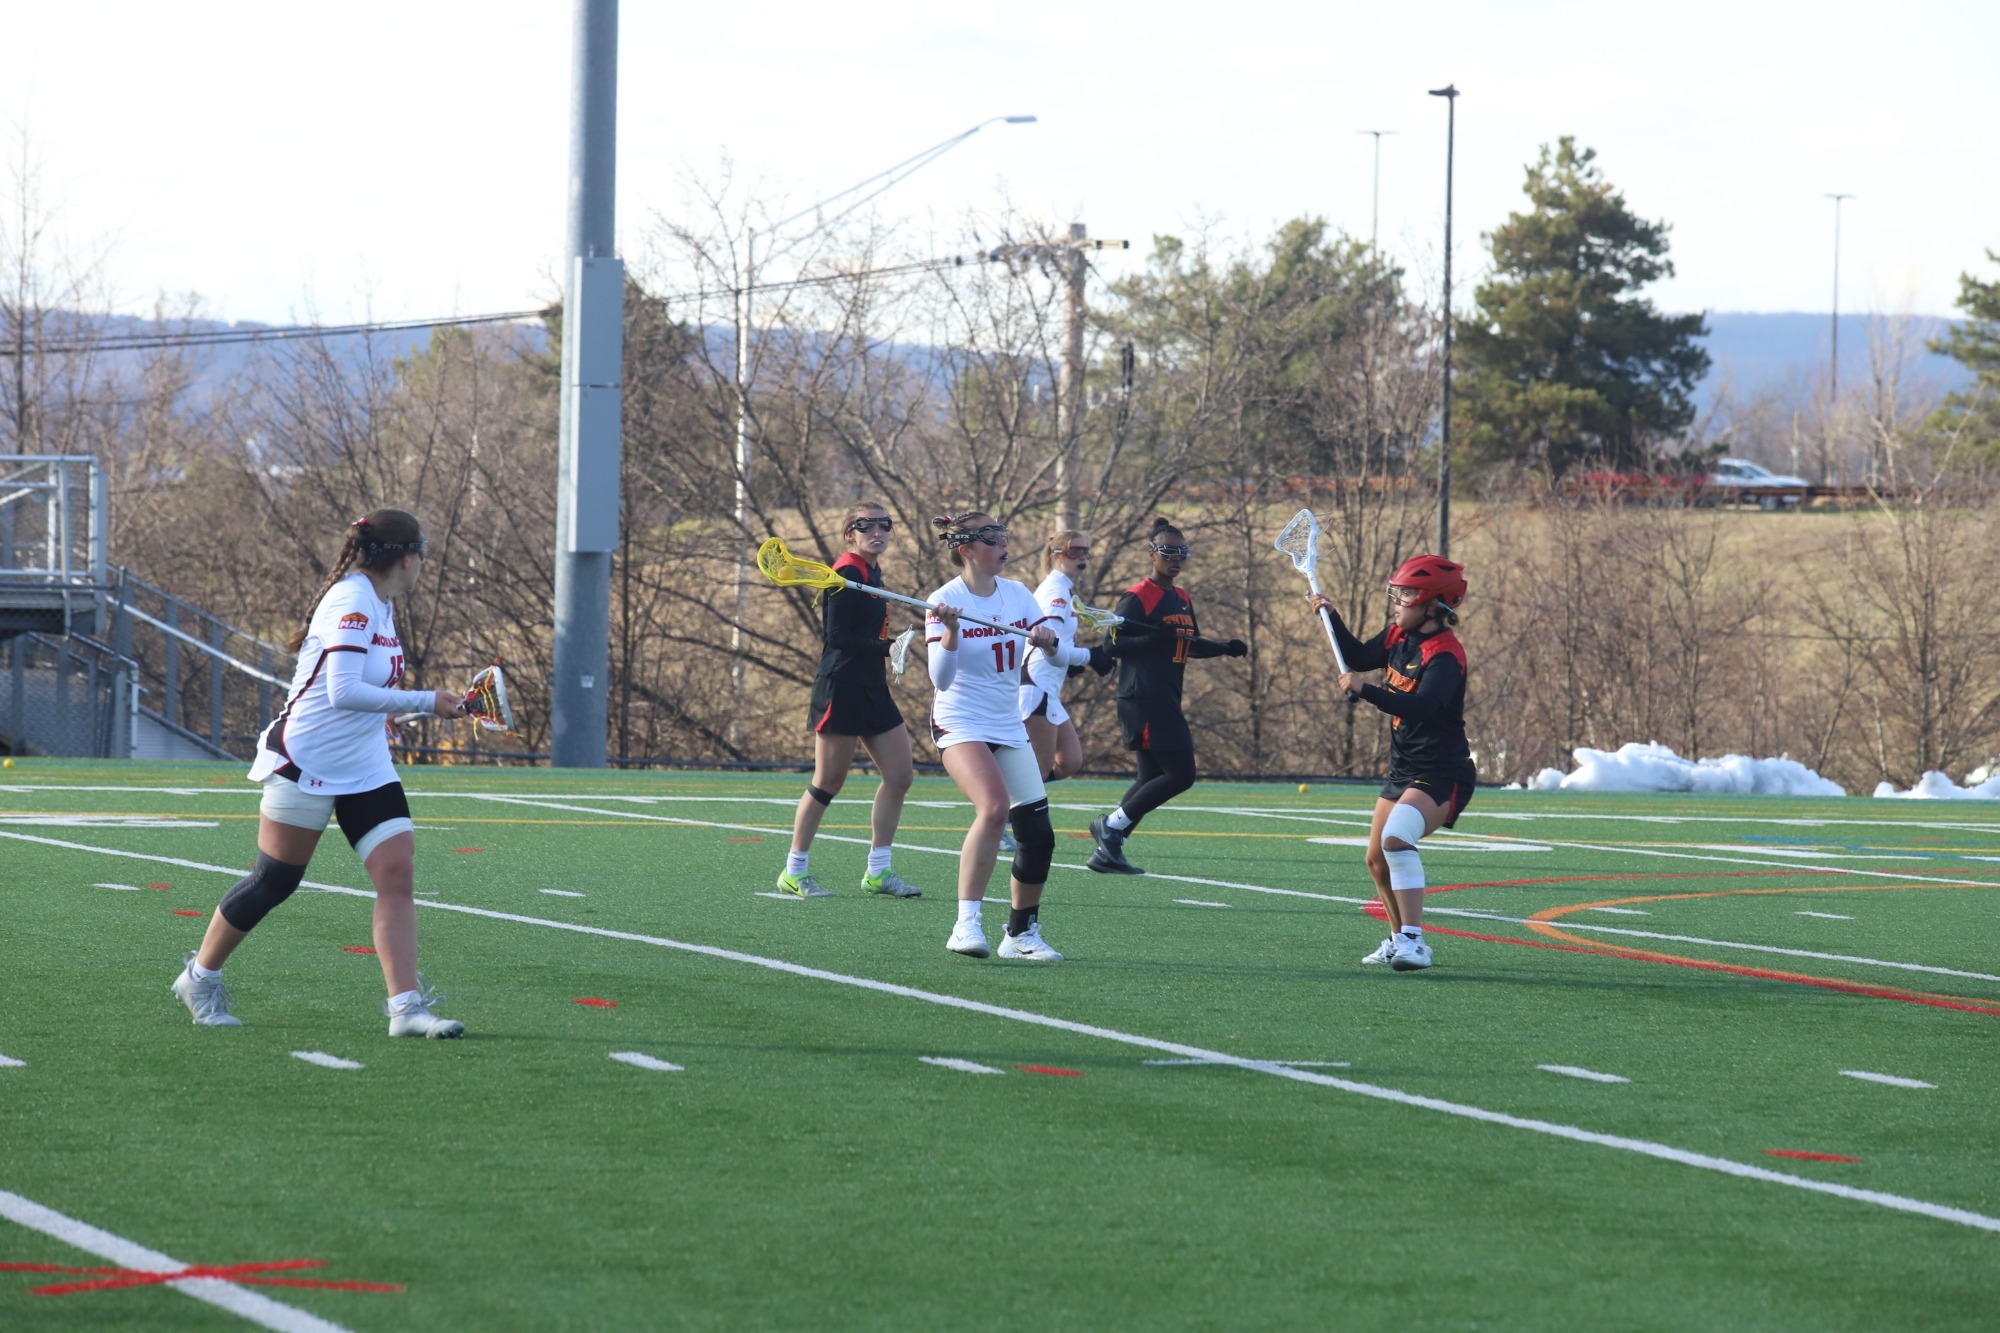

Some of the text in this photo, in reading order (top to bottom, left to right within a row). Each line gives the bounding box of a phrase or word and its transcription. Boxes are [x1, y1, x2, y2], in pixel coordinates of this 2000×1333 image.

[340, 621, 366, 630] MAC
[381, 655, 403, 688] 15
[991, 639, 1015, 673] 11
